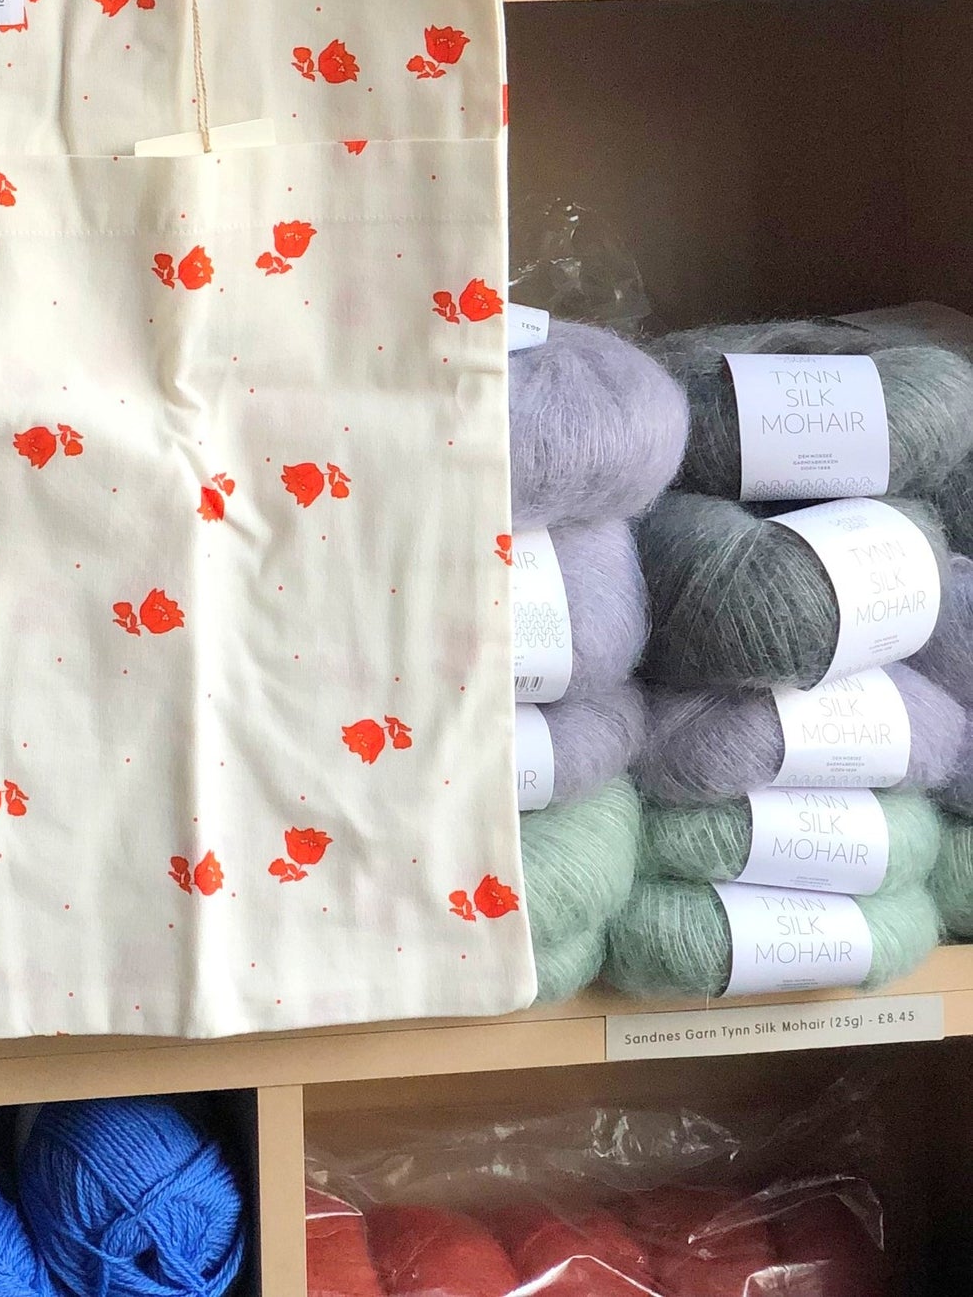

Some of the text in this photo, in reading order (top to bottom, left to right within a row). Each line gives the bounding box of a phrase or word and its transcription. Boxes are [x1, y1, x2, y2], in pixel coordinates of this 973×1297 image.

[769, 370, 842, 384] TYNN
[785, 388, 834, 407] SILK
[762, 411, 866, 434] MOHAIR
[847, 540, 906, 566] TYNN
[870, 567, 906, 595] SILK
[856, 590, 927, 627] MOHAIR
[819, 697, 864, 717] SILK
[802, 723, 891, 745] MOHAIR
[780, 791, 848, 810] TYNN
[798, 811, 843, 835] SILK
[772, 837, 869, 865] MOHAIR
[755, 896, 826, 911] TYNN
[777, 915, 824, 936] SILK
[755, 941, 852, 964] MOHAIR
[625, 1032, 681, 1045] Sandnes
[685, 1028, 717, 1040] Garn
[721, 1026, 750, 1039] Tynn
[755, 1023, 777, 1035] Silk
[782, 1019, 827, 1032] Mohair
[829, 1015, 864, 1029] (25g)
[878, 1011, 915, 1024] £8.45
